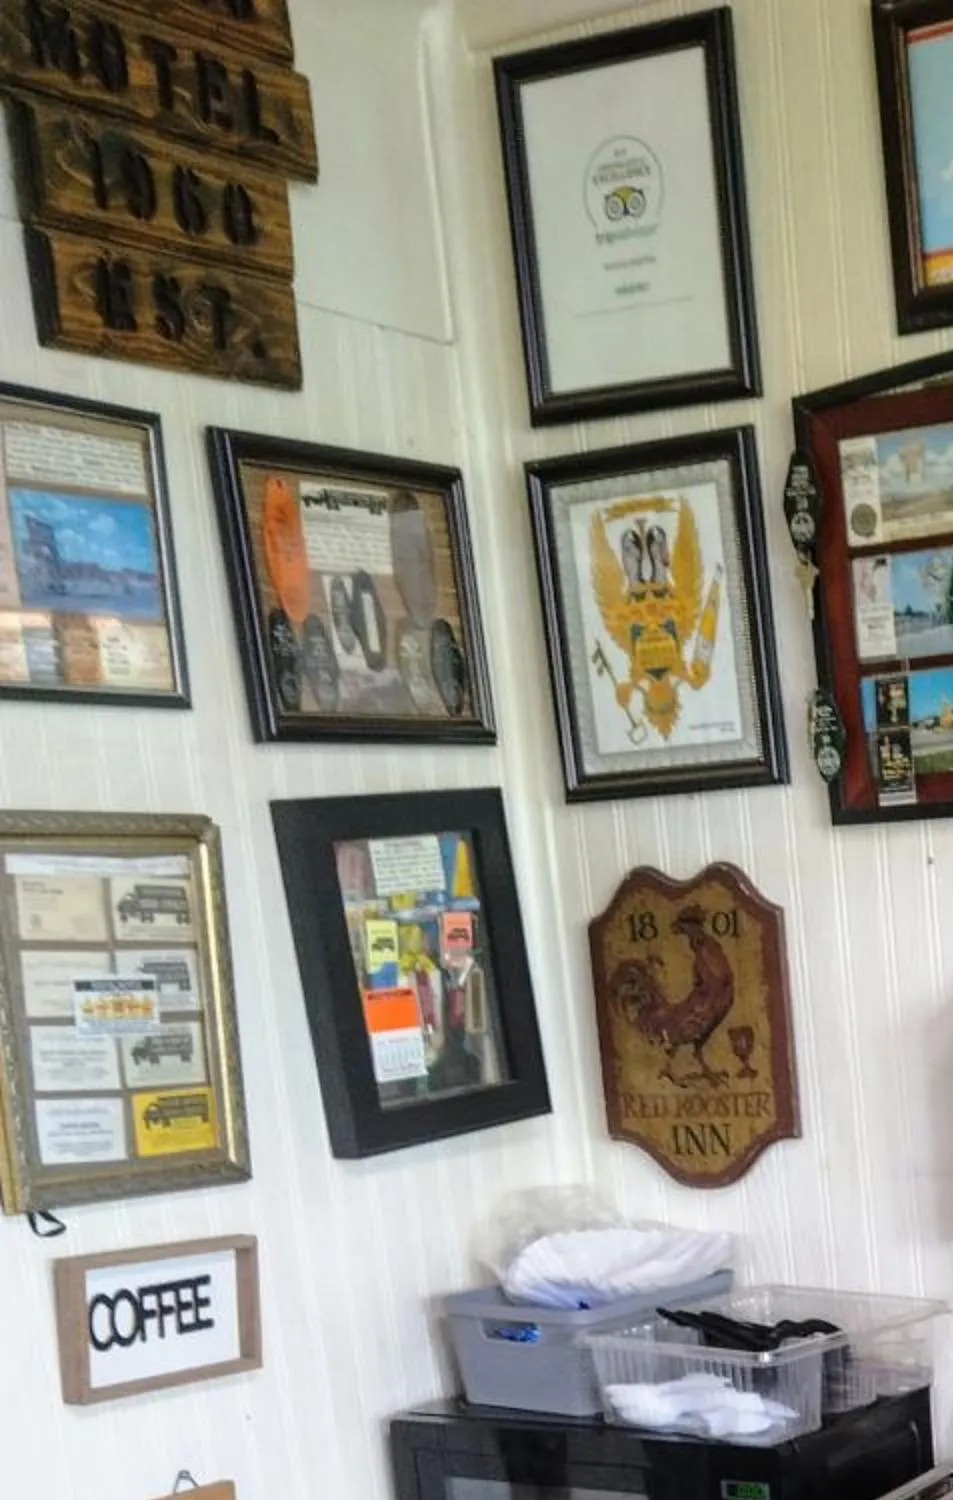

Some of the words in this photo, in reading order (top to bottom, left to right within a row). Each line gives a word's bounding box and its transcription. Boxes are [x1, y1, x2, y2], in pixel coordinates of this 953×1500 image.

[626, 912, 659, 943] 18
[711, 911, 739, 939] 01
[621, 1093, 669, 1120] RED
[674, 1090, 772, 1119] ROOSTER
[671, 1122, 732, 1157] INN
[89, 1274, 215, 1352] COFFEE
